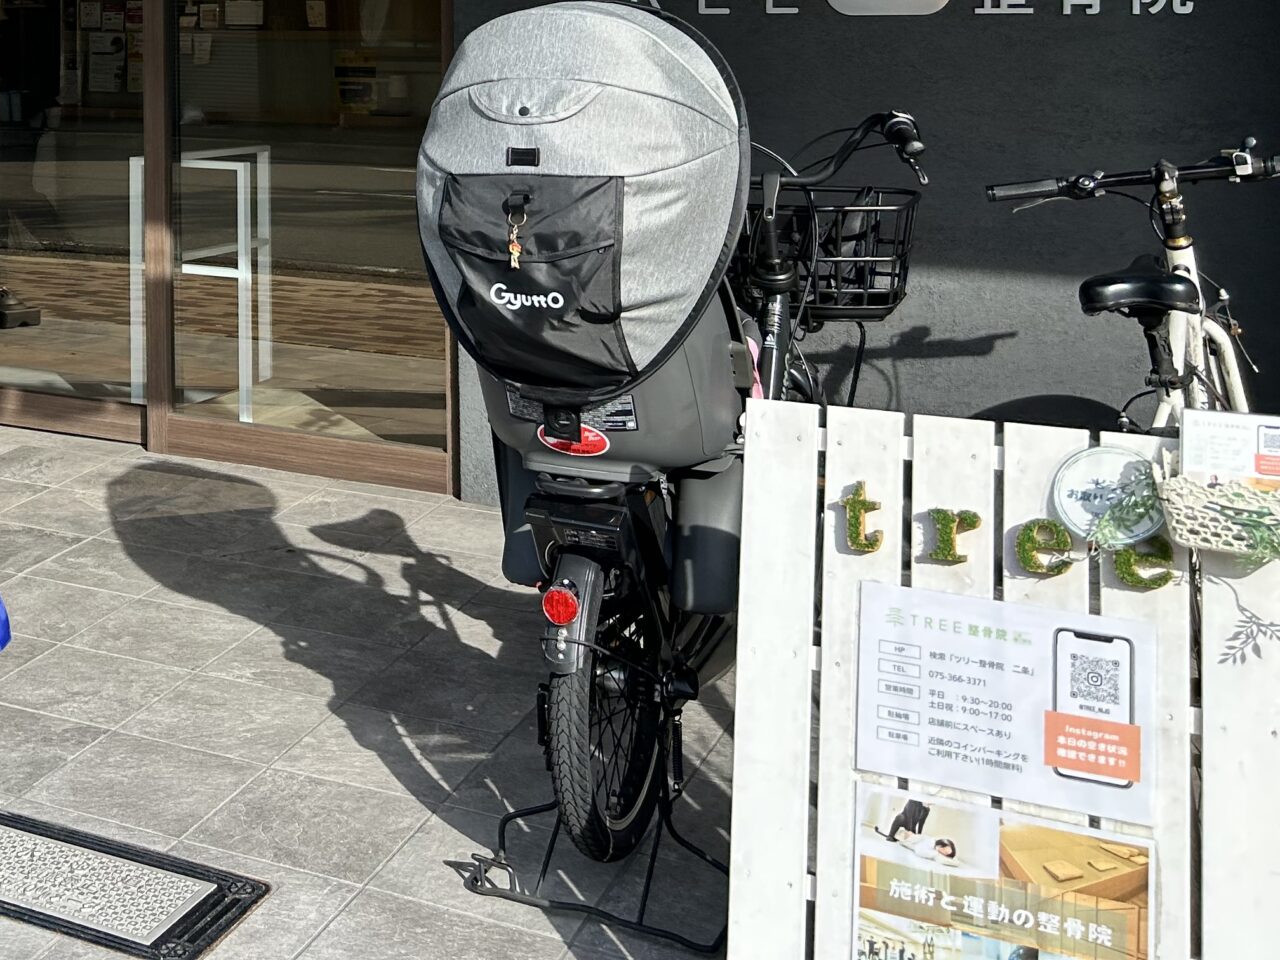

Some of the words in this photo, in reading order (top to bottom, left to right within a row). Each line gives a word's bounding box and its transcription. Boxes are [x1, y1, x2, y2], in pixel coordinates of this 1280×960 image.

[839, 480, 1175, 591] tree
[911, 614, 962, 633] TREE
[967, 624, 1008, 643] 整骨院
[892, 663, 907, 673] TEL
[928, 669, 987, 688] 075-366-3371
[1065, 725, 1120, 741] Instagram
[888, 878, 1114, 947] 施術と運動の整骨院
